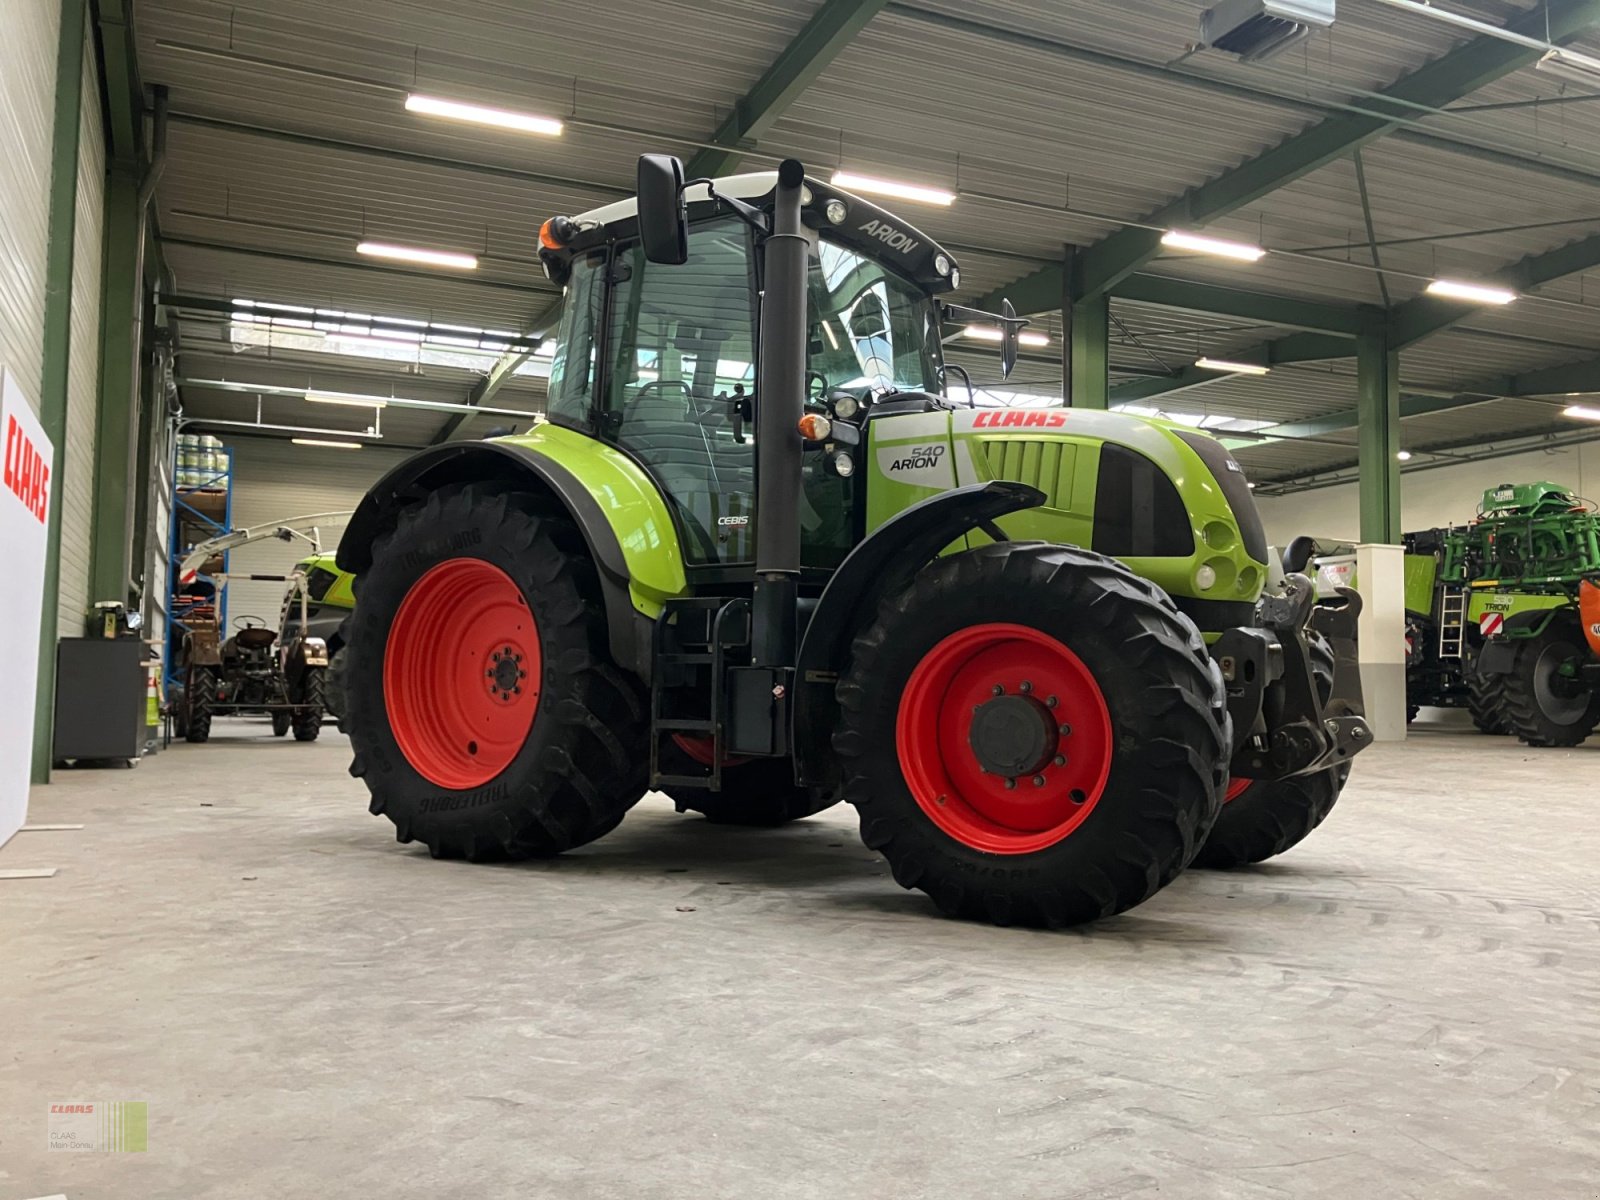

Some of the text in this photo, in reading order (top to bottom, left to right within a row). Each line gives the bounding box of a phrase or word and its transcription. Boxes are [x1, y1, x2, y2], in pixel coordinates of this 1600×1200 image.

[858, 219, 919, 254] ARION
[972, 411, 1069, 428] CLAAS
[911, 446, 945, 459] 540
[4, 413, 49, 525] CLAAS
[890, 457, 938, 471] ARION
[717, 515, 749, 525] CEBIS
[1485, 603, 1510, 612] TRION
